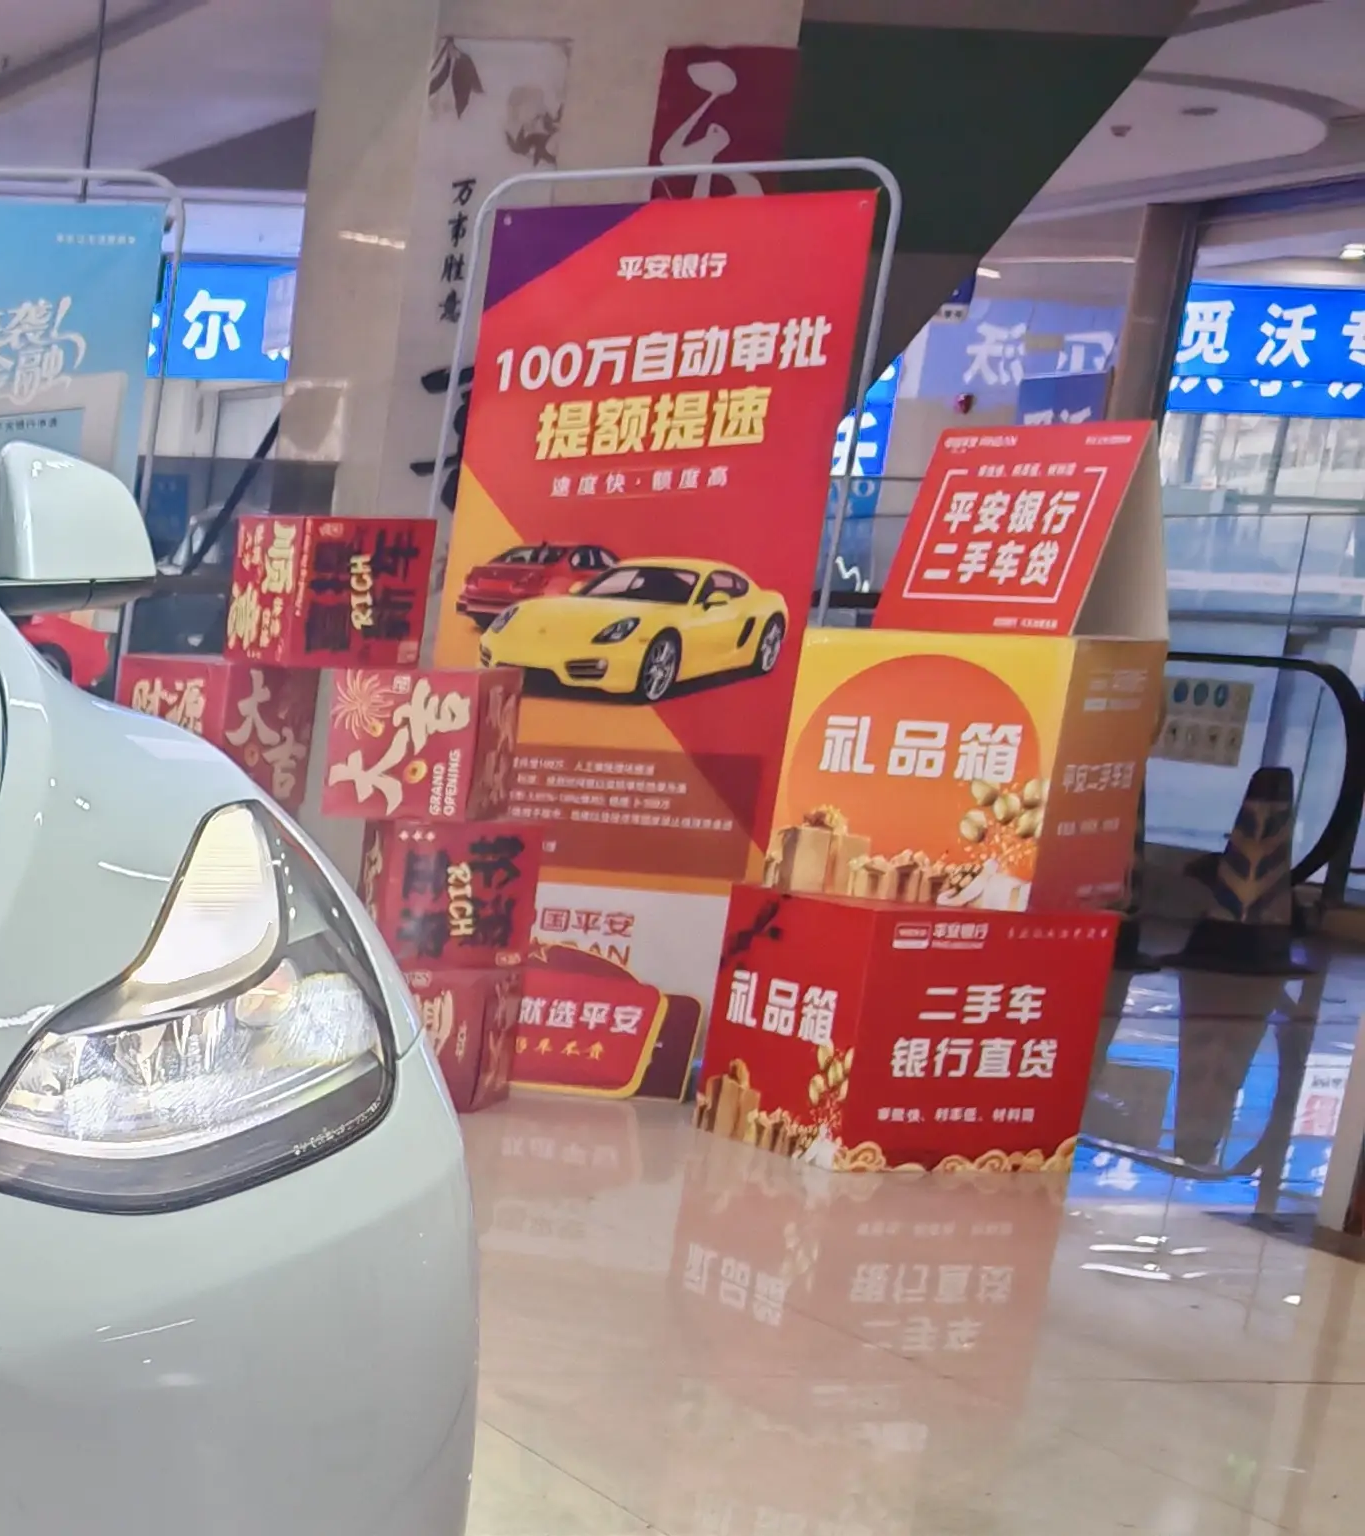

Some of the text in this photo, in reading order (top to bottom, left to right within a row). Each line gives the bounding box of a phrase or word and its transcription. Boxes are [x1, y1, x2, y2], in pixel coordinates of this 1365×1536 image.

[616, 252, 727, 281] 平安银行
[181, 289, 246, 360] 尔
[495, 316, 832, 392] 100万自动审批
[534, 386, 772, 460] 提额提速
[943, 489, 1081, 535] 平安银行
[350, 555, 374, 630] RICH
[922, 541, 1059, 586] 二手车贷
[443, 748, 462, 817] OPENING
[819, 715, 1024, 783] 礼品箱
[429, 762, 446, 816] GRAND
[447, 862, 474, 937] RICH
[726, 969, 838, 1045] 礼品箱
[918, 982, 1047, 1025] 二手车
[889, 1036, 1059, 1079] 银行直贷
